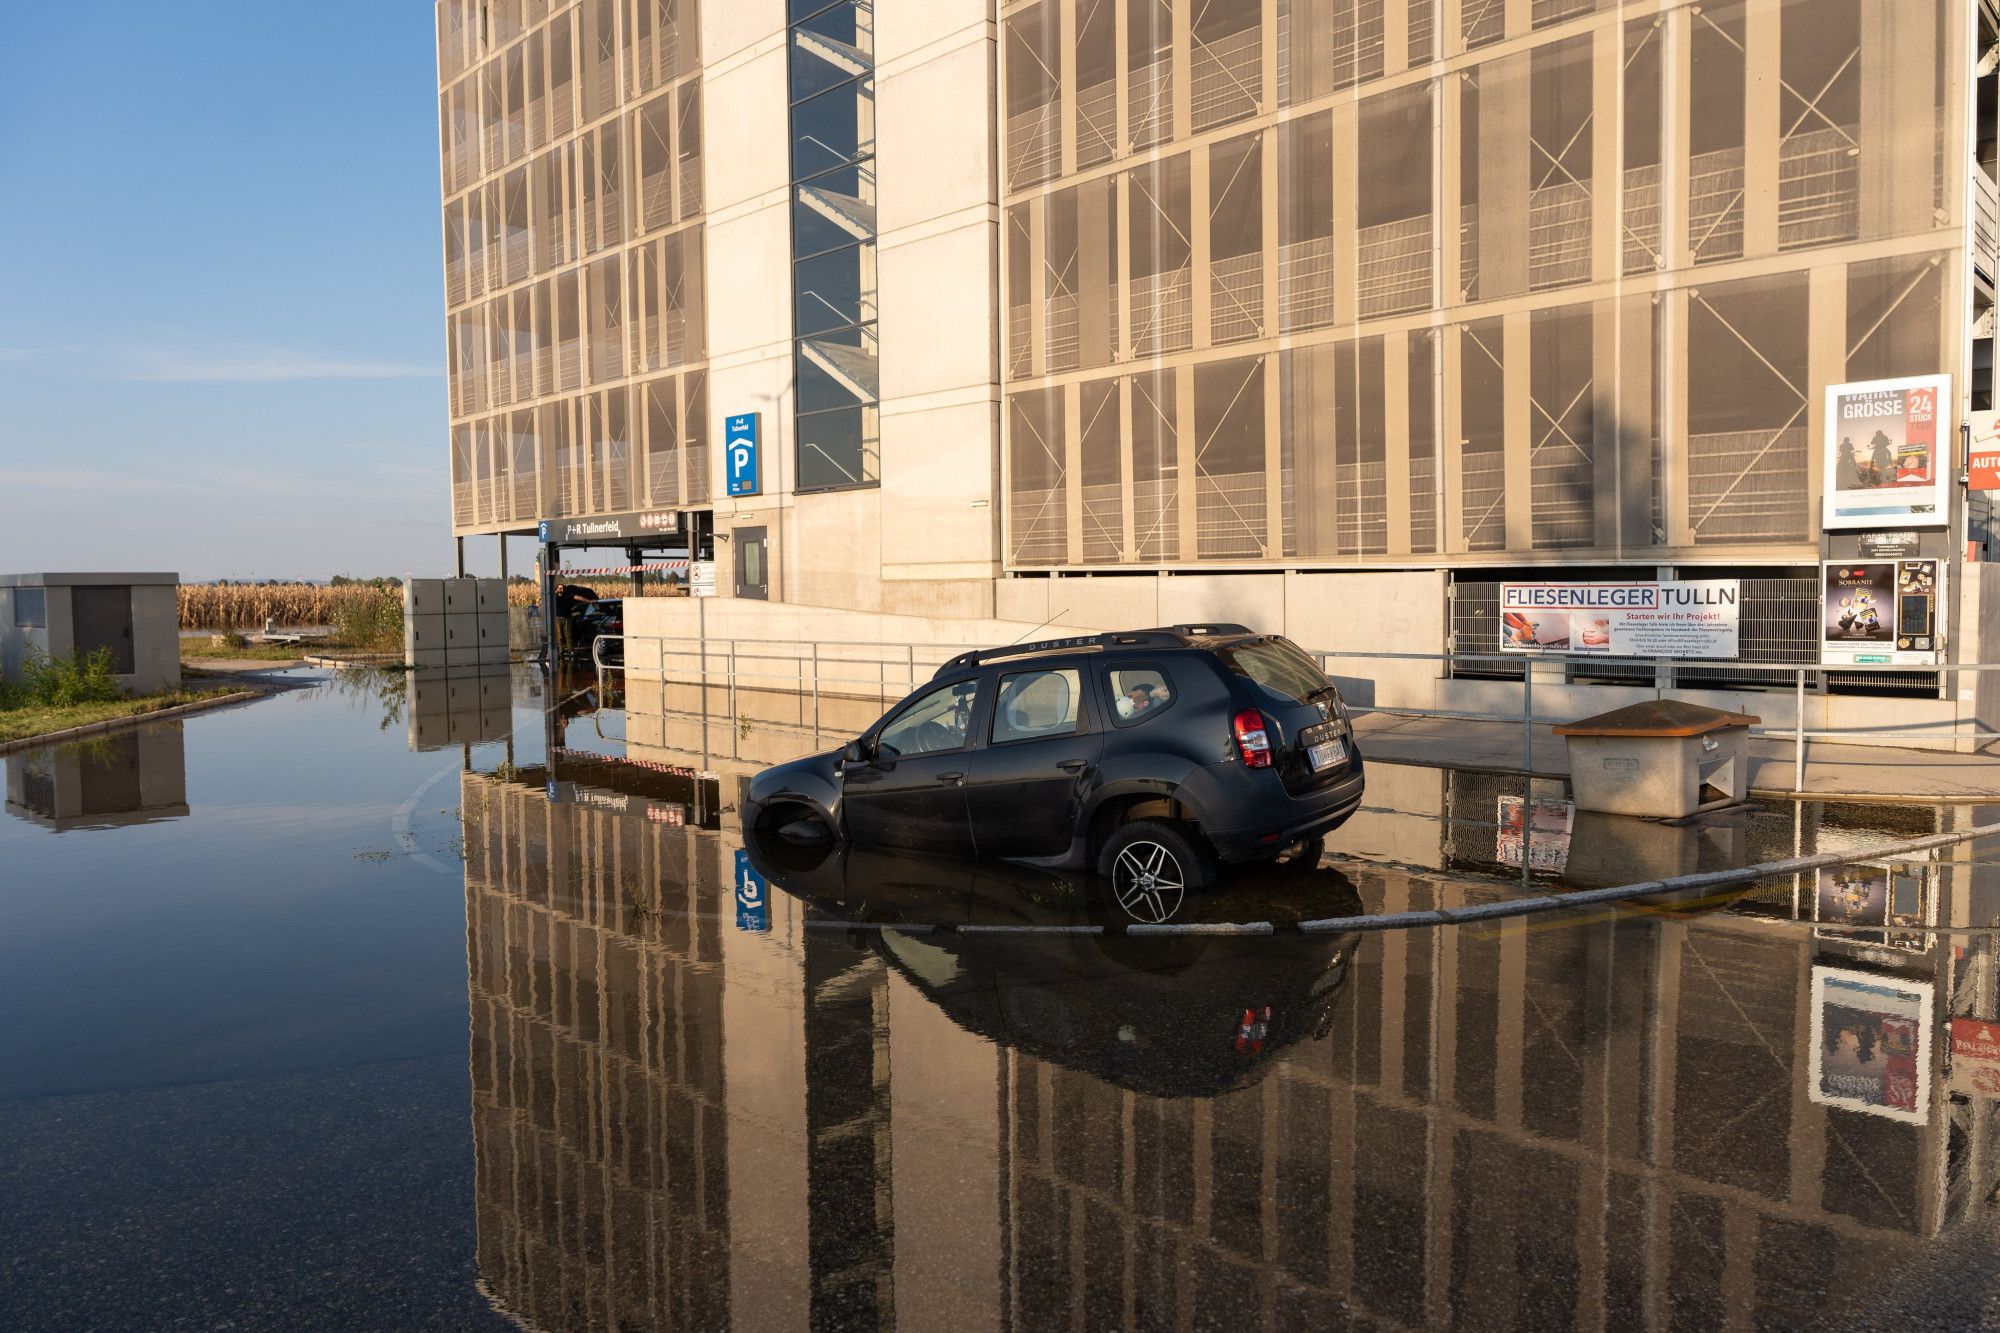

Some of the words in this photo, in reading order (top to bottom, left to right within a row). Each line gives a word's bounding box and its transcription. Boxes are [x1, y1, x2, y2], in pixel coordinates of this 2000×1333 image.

[1843, 399, 1903, 419] GRÖSSE
[1909, 395, 1933, 414] 24
[734, 448, 749, 478] P
[541, 526, 547, 539] P
[567, 523, 581, 535] P+R
[582, 520, 619, 534] Tullnerfeld
[1506, 589, 1654, 605] FLIESENLEGER
[1661, 588, 1735, 605] TULLN
[1686, 613, 1720, 621] Projekt!
[1030, 637, 1096, 650] DUSTER
[1314, 728, 1341, 743] DUSTER
